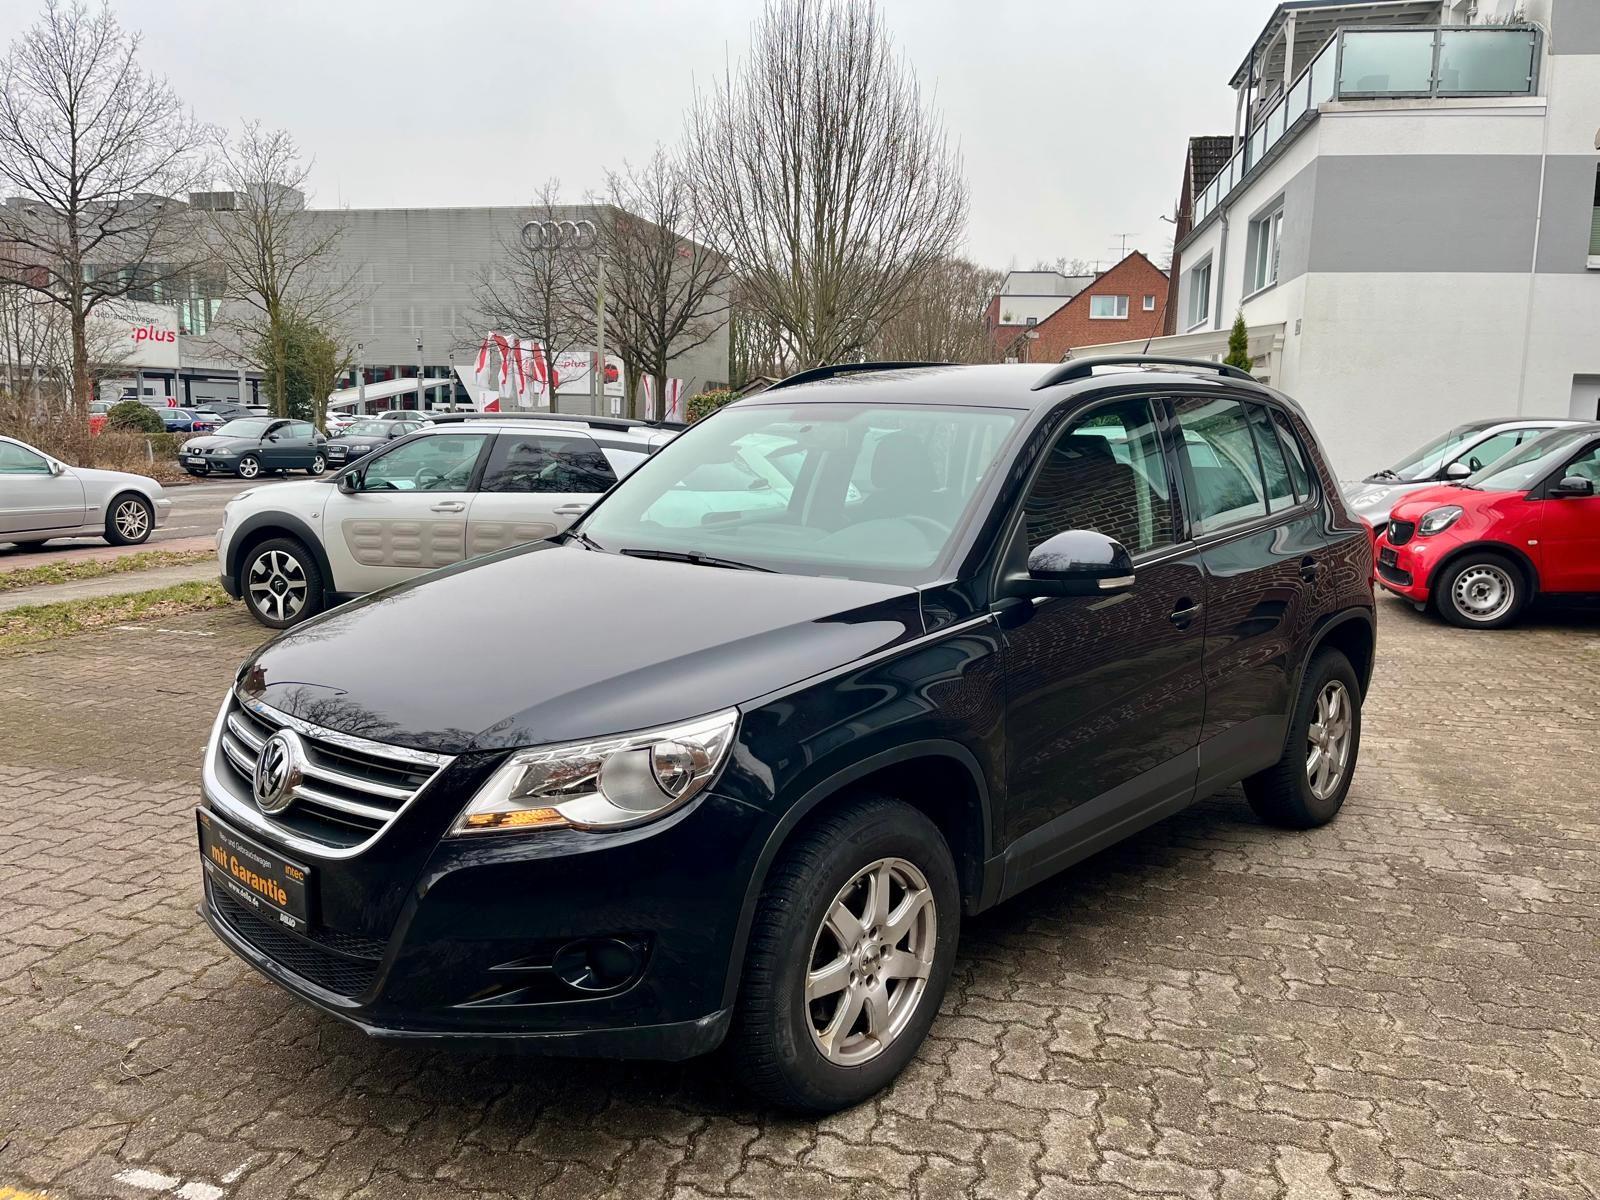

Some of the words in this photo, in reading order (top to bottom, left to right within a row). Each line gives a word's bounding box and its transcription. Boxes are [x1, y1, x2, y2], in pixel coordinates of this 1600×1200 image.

[94, 309, 159, 324] Gebrauchtwagen
[211, 844, 228, 869] mit
[230, 856, 288, 906] Garantie
[284, 864, 304, 881] intec
